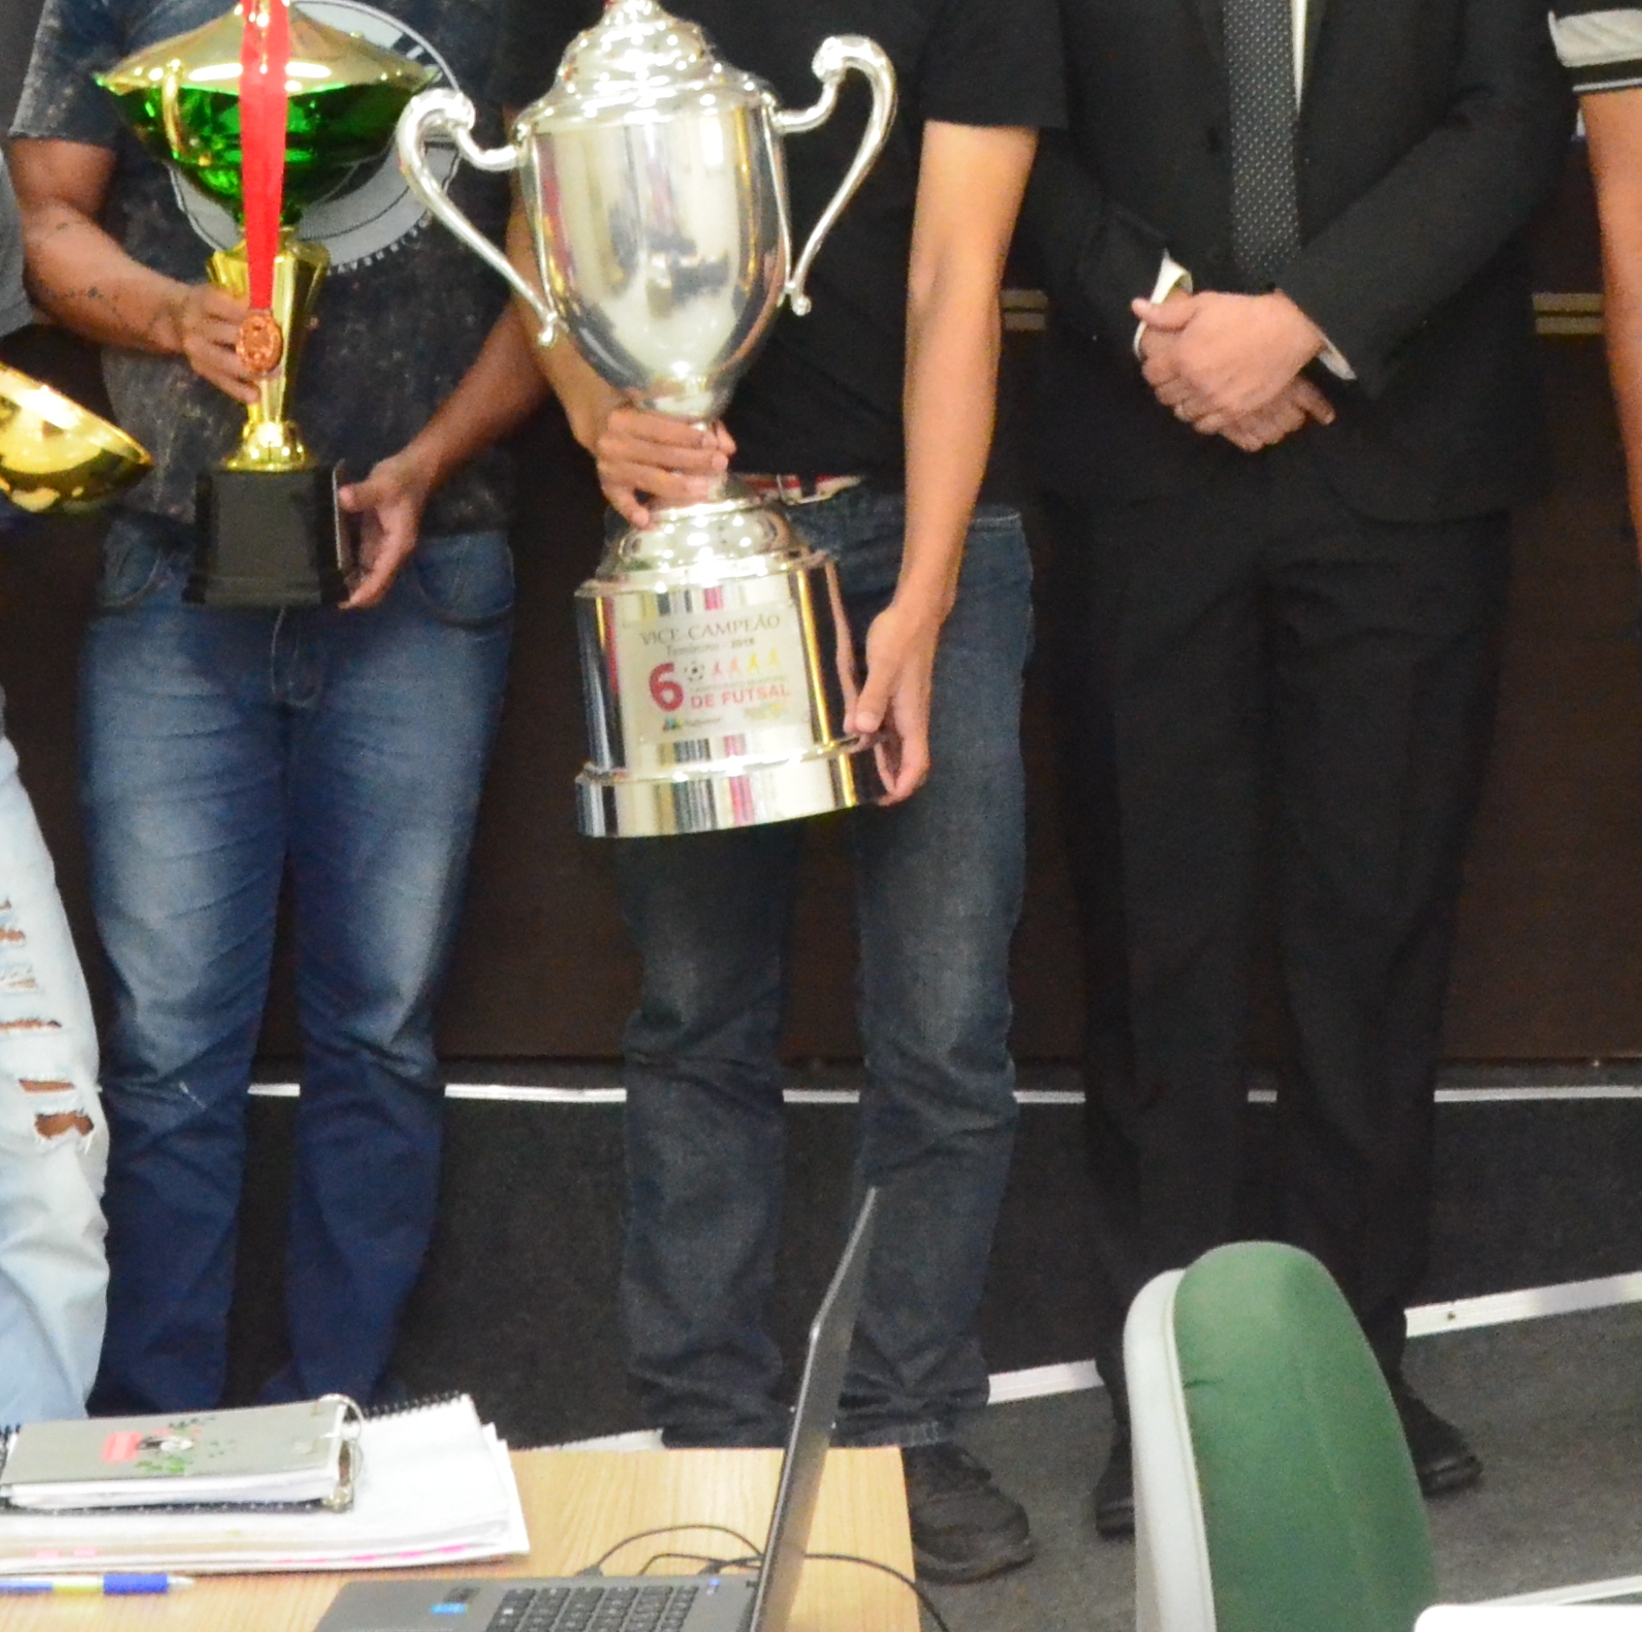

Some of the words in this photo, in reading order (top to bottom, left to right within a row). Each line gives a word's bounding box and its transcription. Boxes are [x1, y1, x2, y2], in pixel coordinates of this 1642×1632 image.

[687, 615, 781, 641] CAMPEÃO
[649, 661, 685, 713] 6
[690, 693, 714, 710] DE
[721, 683, 792, 706] FUTSAL
